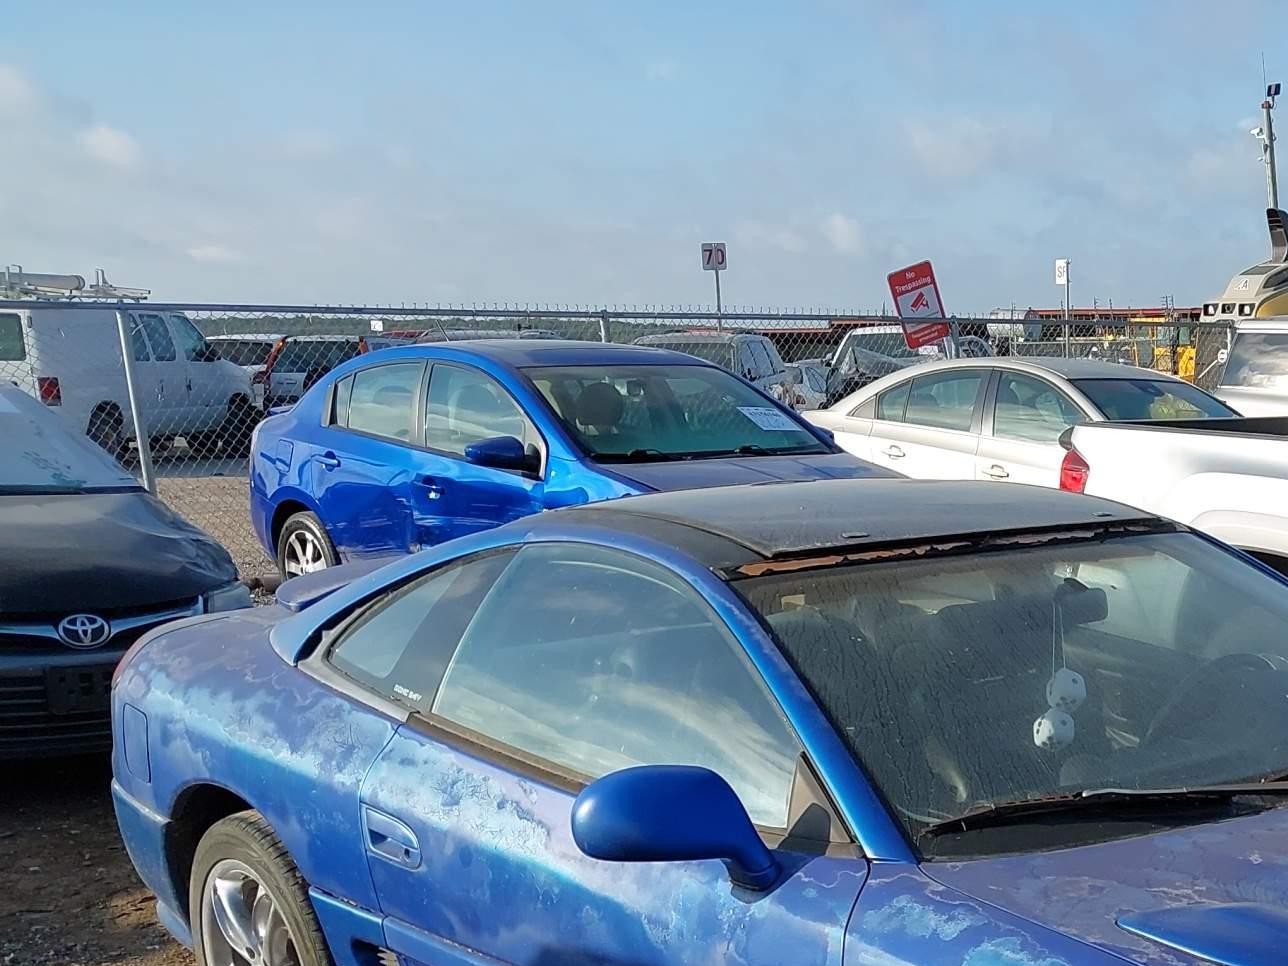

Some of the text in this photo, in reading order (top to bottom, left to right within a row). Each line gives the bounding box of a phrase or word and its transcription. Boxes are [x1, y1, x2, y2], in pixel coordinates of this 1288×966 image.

[703, 248, 725, 265] 70
[895, 275, 931, 293] Trespassing
[905, 271, 916, 280] No
